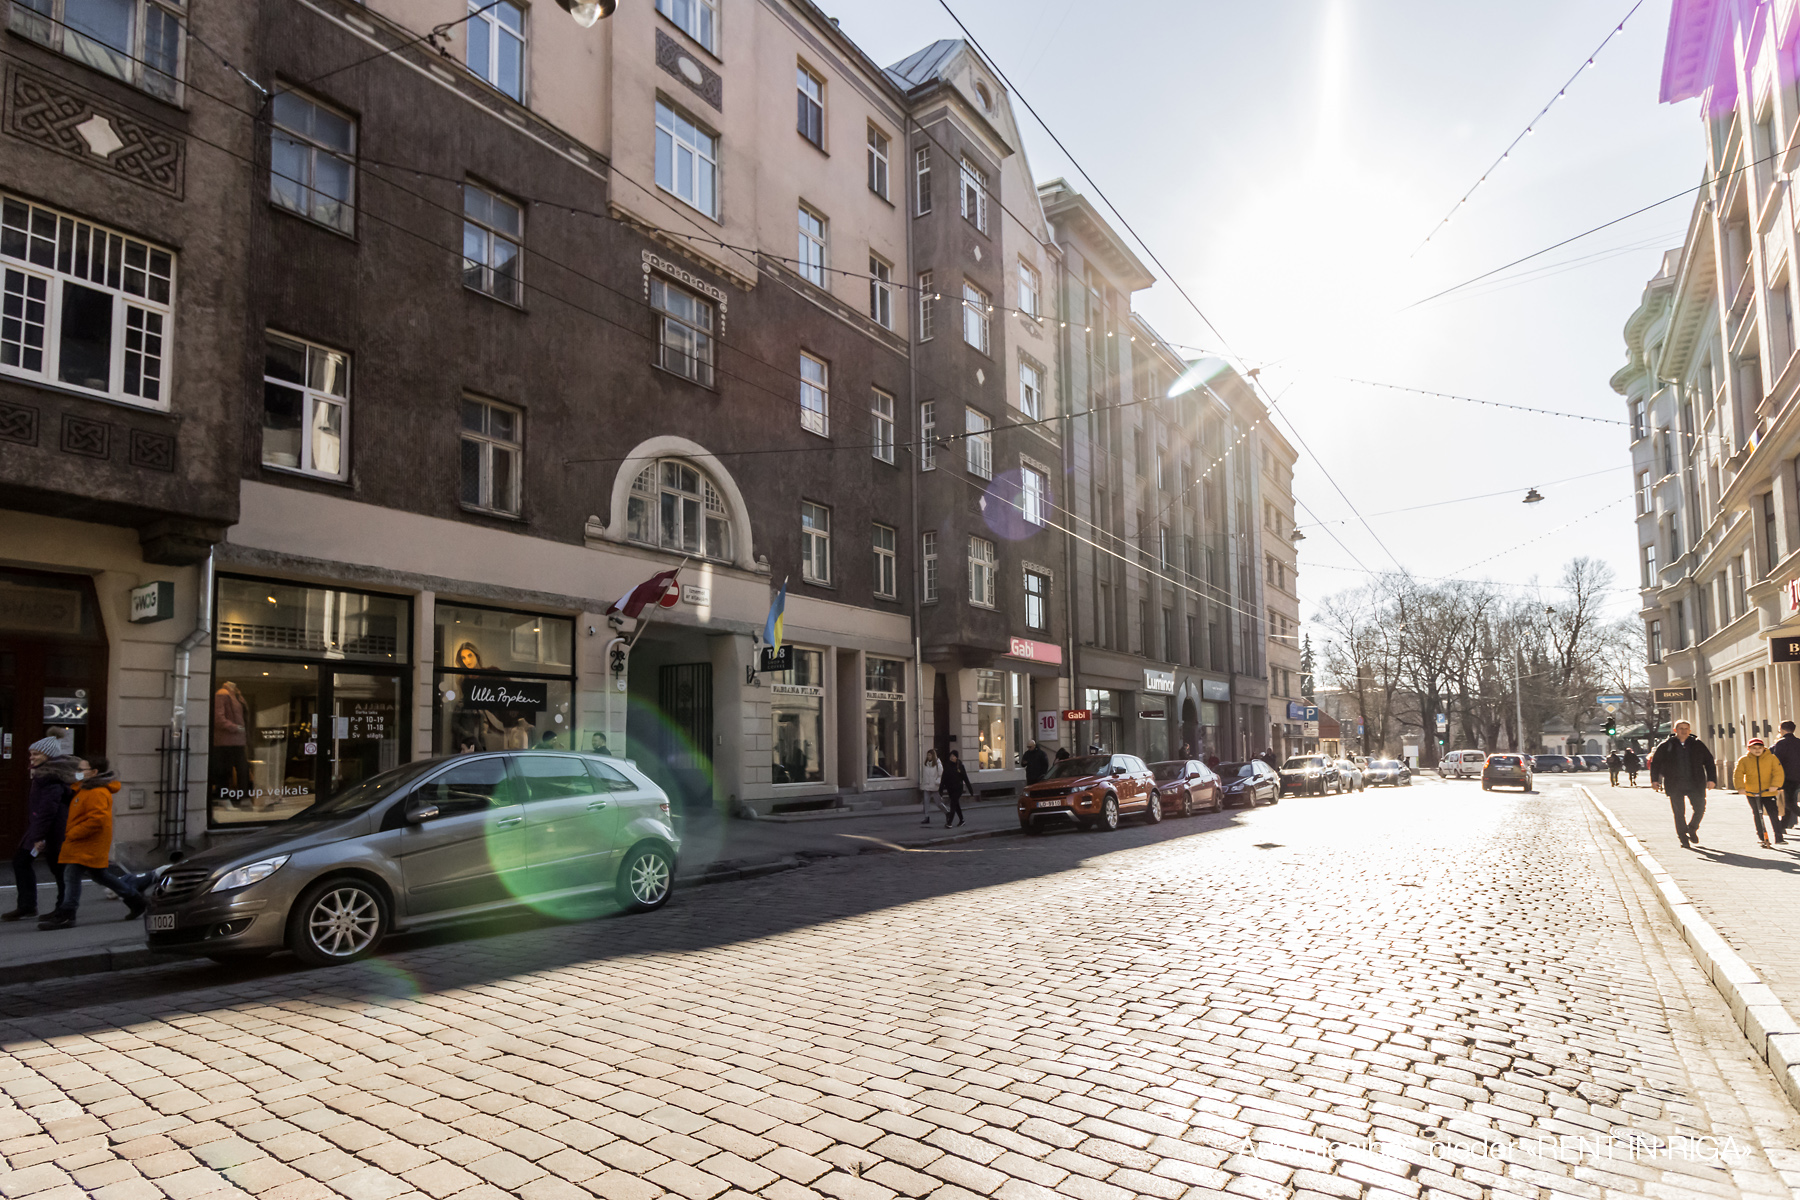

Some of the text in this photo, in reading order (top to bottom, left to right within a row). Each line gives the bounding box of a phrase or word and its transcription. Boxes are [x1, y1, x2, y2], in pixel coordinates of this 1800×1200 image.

[1011, 639, 1034, 658] Gabi
[773, 686, 799, 694] FABIANA
[1146, 673, 1174, 692] Luminor
[471, 685, 540, 707] Ulla Popken
[1067, 711, 1086, 719] Gabi
[1306, 708, 1315, 719] P
[220, 785, 309, 800] Pop up veikals
